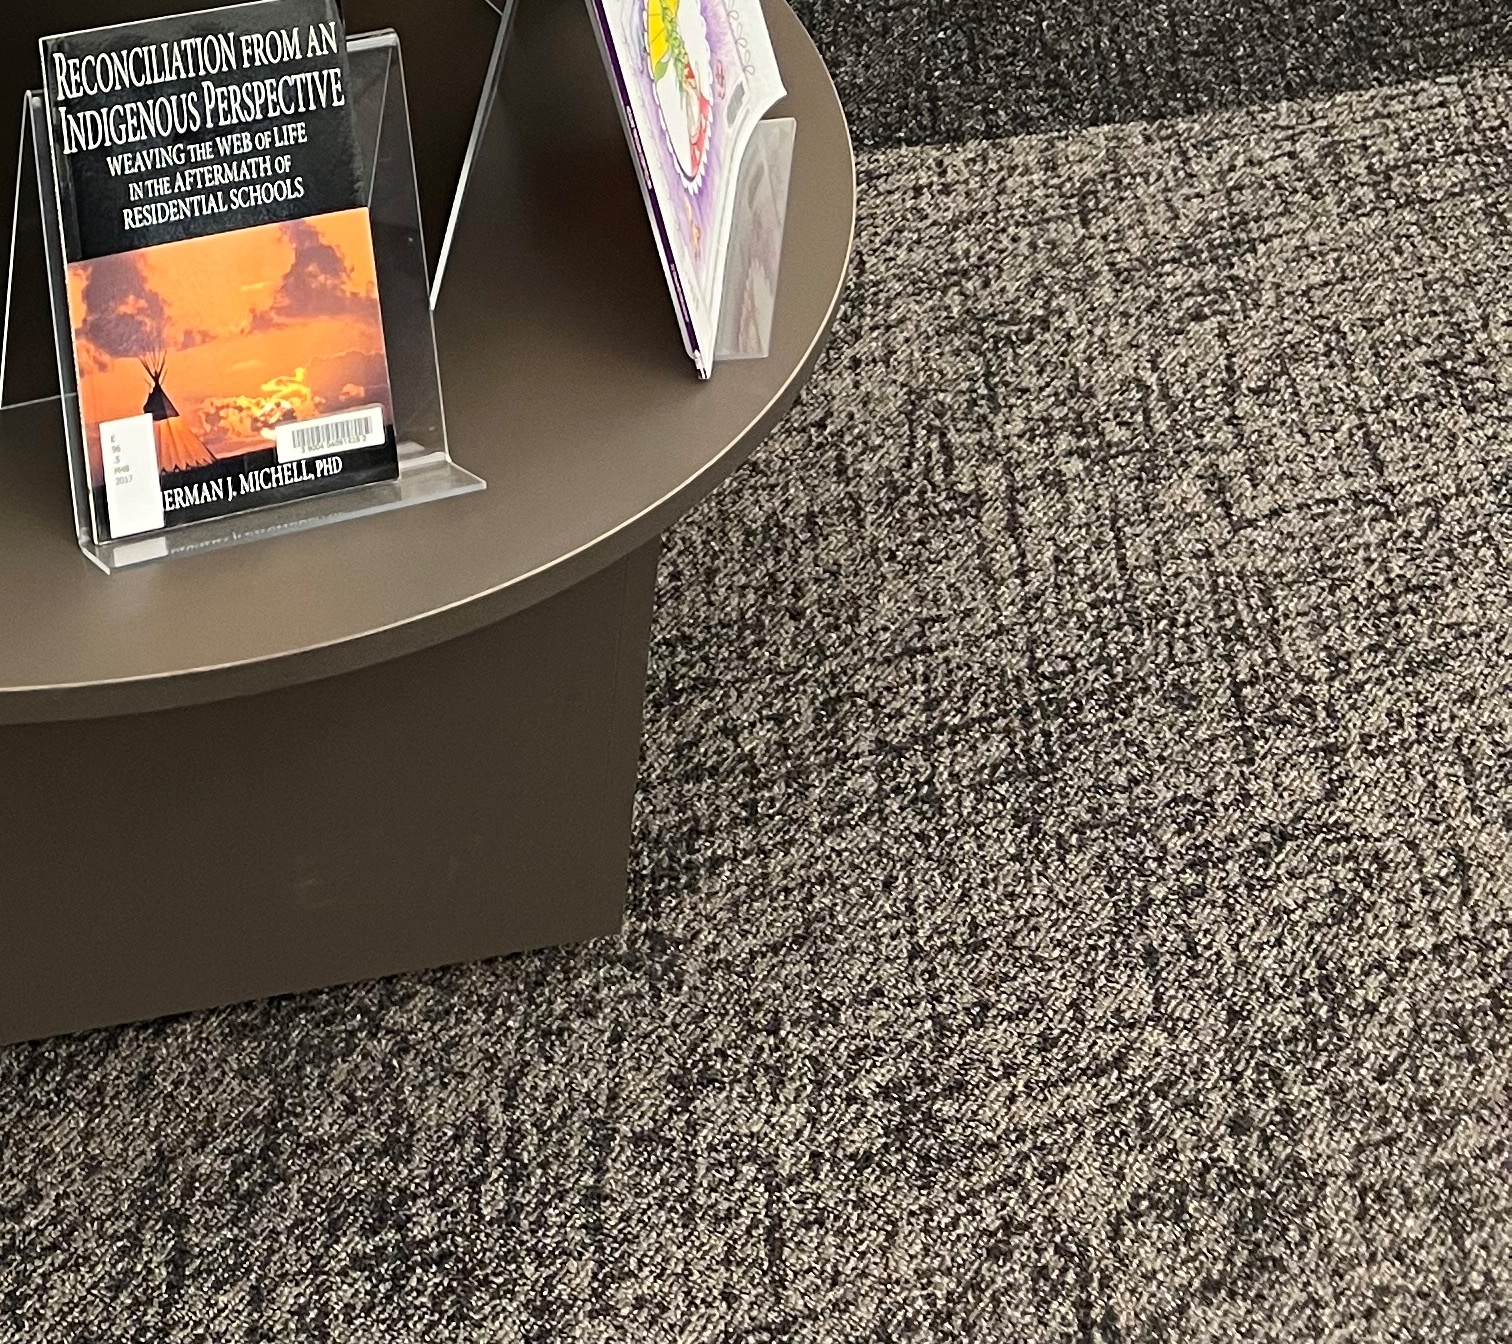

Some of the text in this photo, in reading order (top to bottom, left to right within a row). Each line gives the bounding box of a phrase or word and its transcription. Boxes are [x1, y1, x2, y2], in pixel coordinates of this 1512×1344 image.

[52, 21, 339, 102] RECONCILIATION FROM AN
[58, 67, 346, 155] INDIGENOUS PERSPECTIVE
[106, 121, 308, 177] WEAVING THE WEB OF LIFE
[122, 176, 305, 231] RESIDENTIAL SCHOOLS
[128, 154, 292, 202] IN THE AFTERMATH OF
[115, 474, 133, 486] 2017
[226, 476, 237, 502] J.
[239, 459, 316, 495] MICHELL,
[316, 455, 343, 478] PHD
